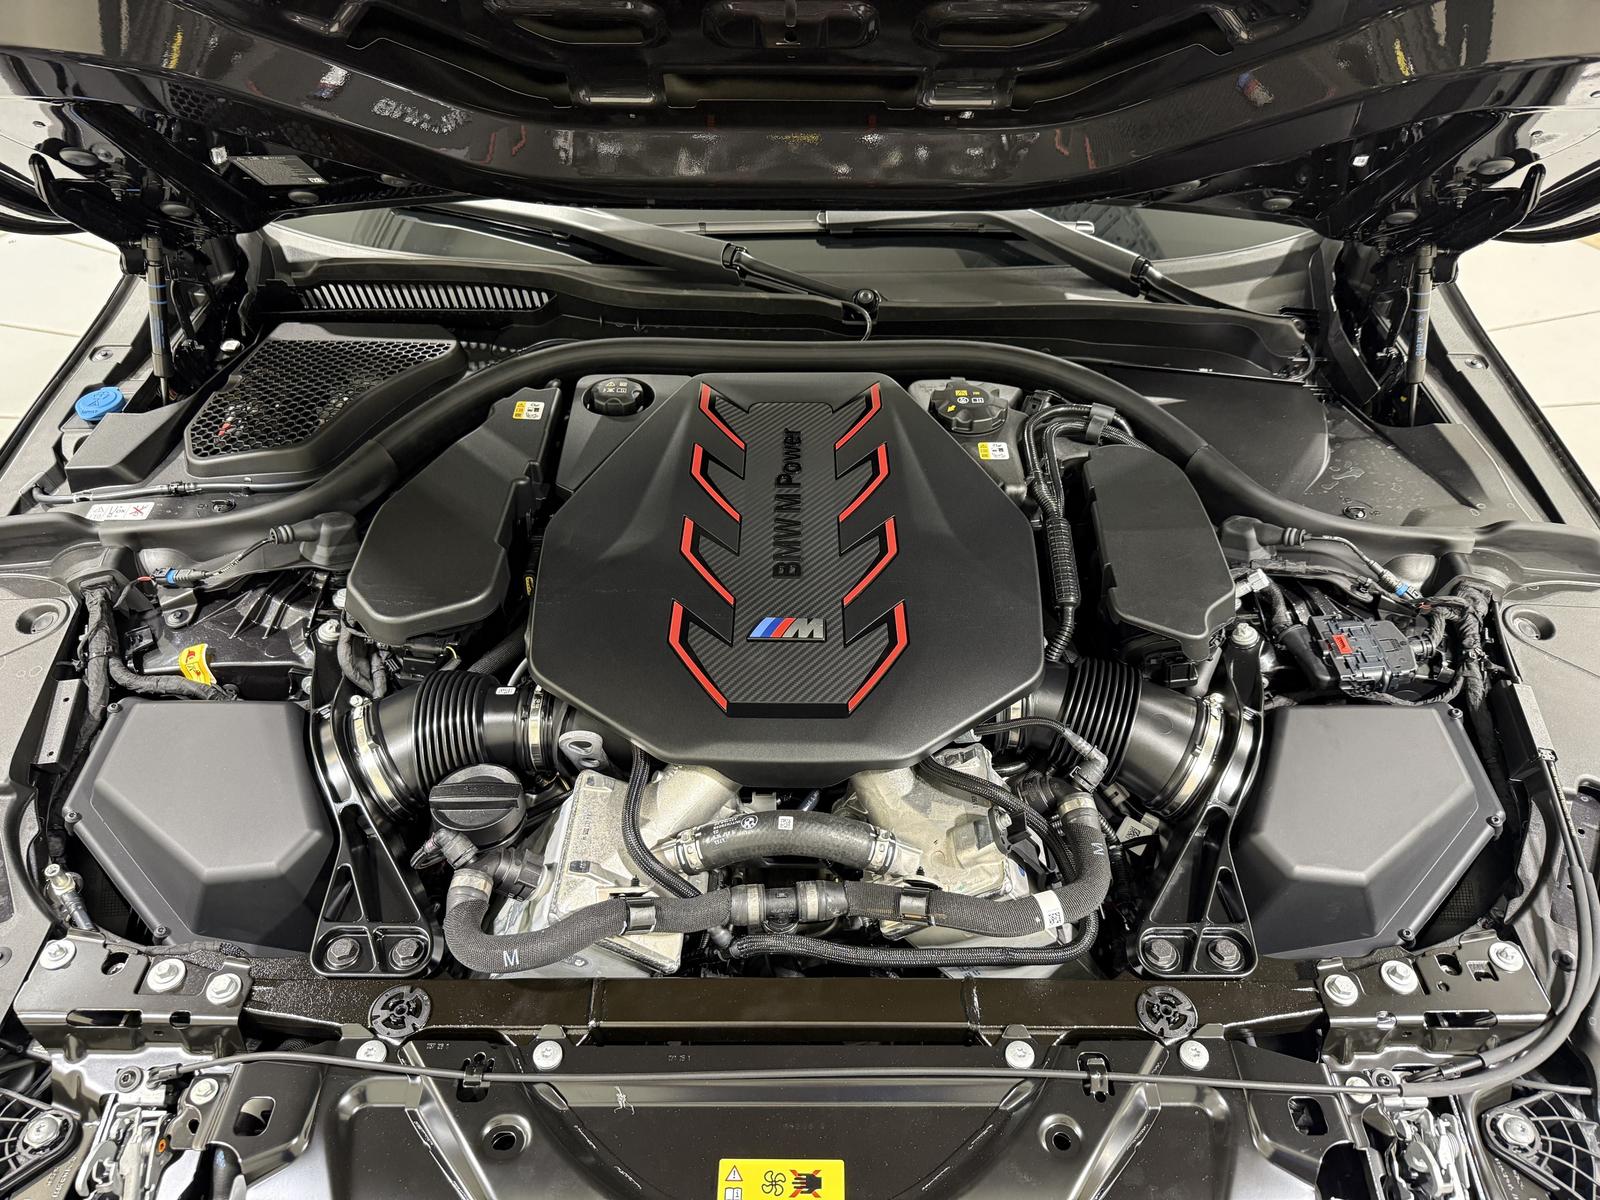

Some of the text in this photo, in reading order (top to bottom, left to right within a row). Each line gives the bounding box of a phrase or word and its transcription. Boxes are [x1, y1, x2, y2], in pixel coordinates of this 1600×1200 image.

[772, 428, 802, 579] BMW M Power
[1091, 842, 1105, 855] M
[503, 949, 519, 967] M
